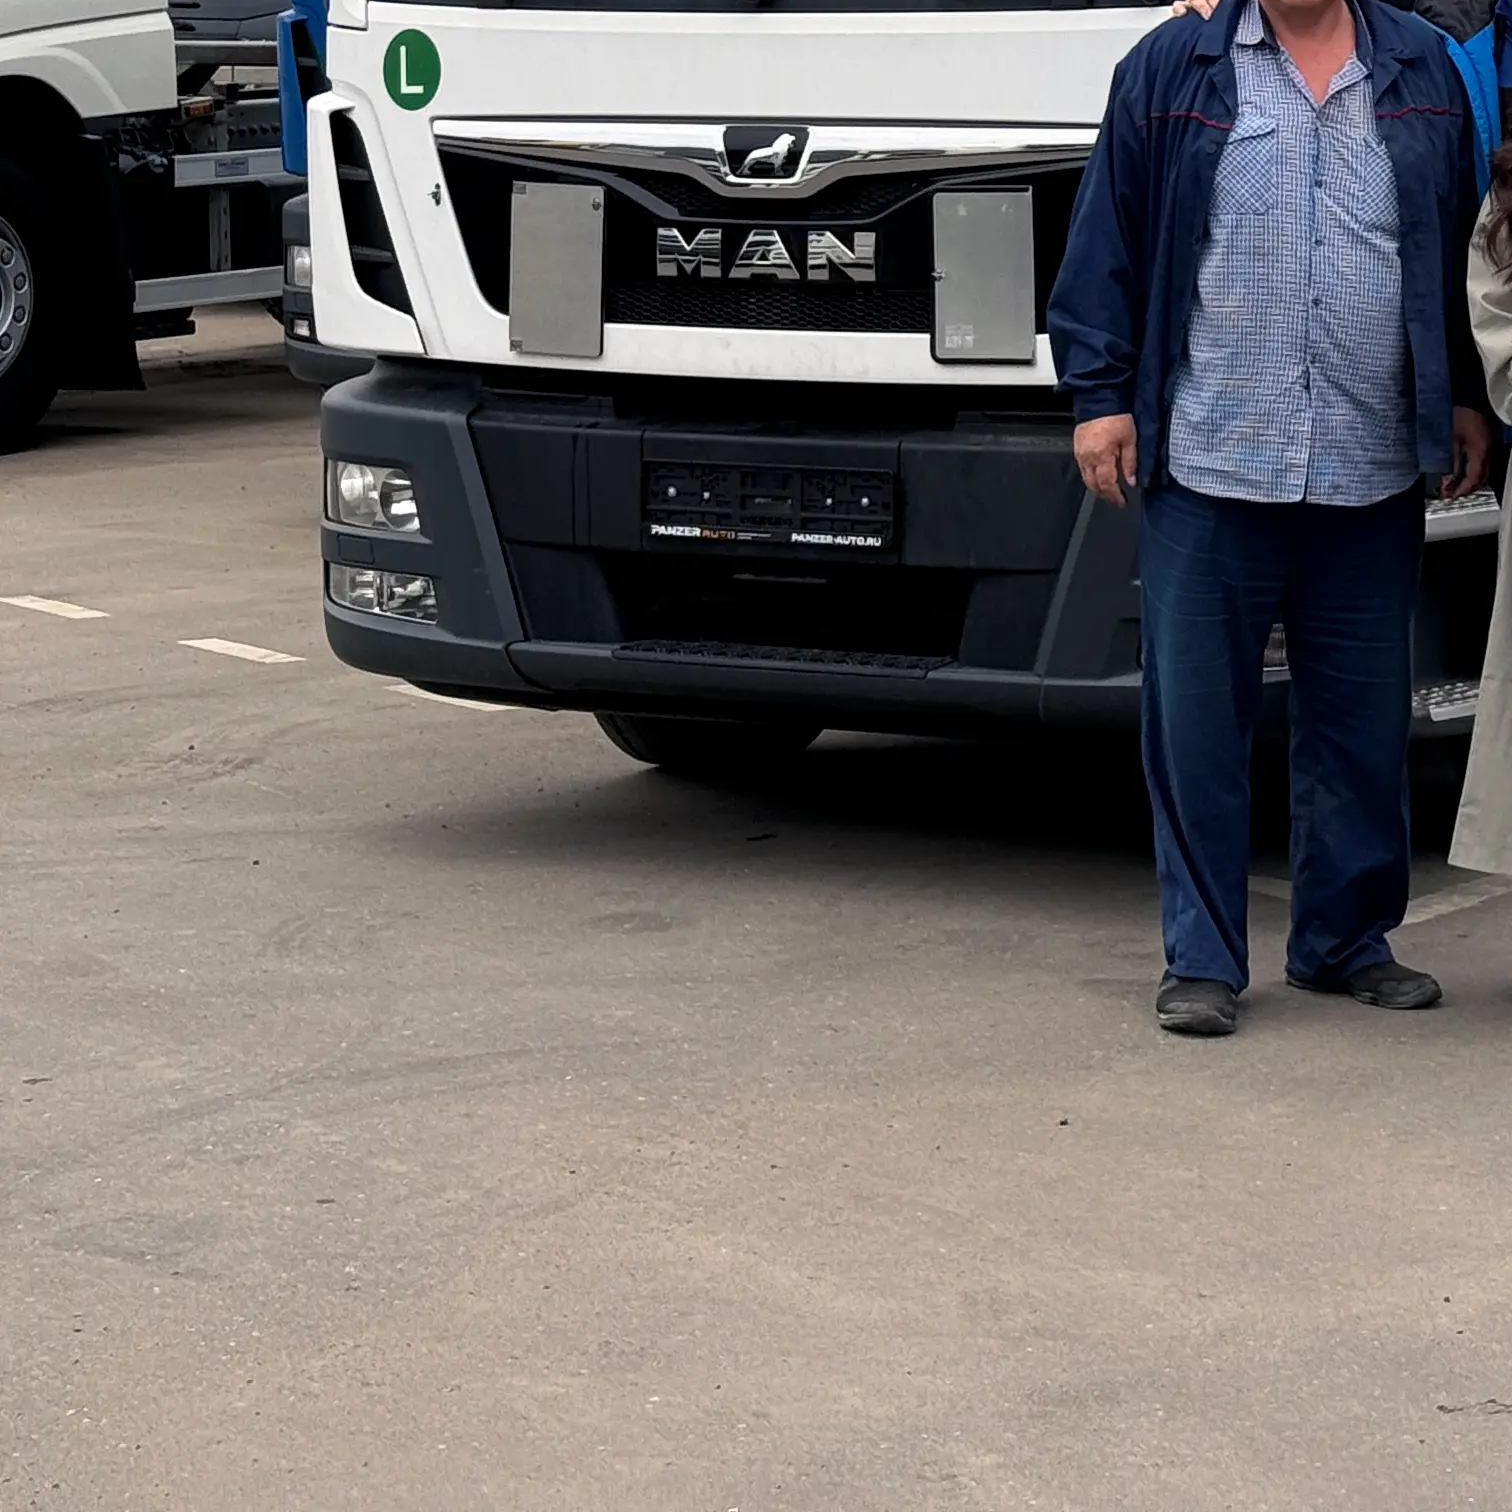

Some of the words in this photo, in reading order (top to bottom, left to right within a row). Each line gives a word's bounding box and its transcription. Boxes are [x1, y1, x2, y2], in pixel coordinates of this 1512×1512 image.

[400, 45, 424, 94] L
[657, 228, 876, 281] MAN
[650, 524, 701, 537] PANZER
[791, 532, 882, 547] PANZER-AUTO.RU
